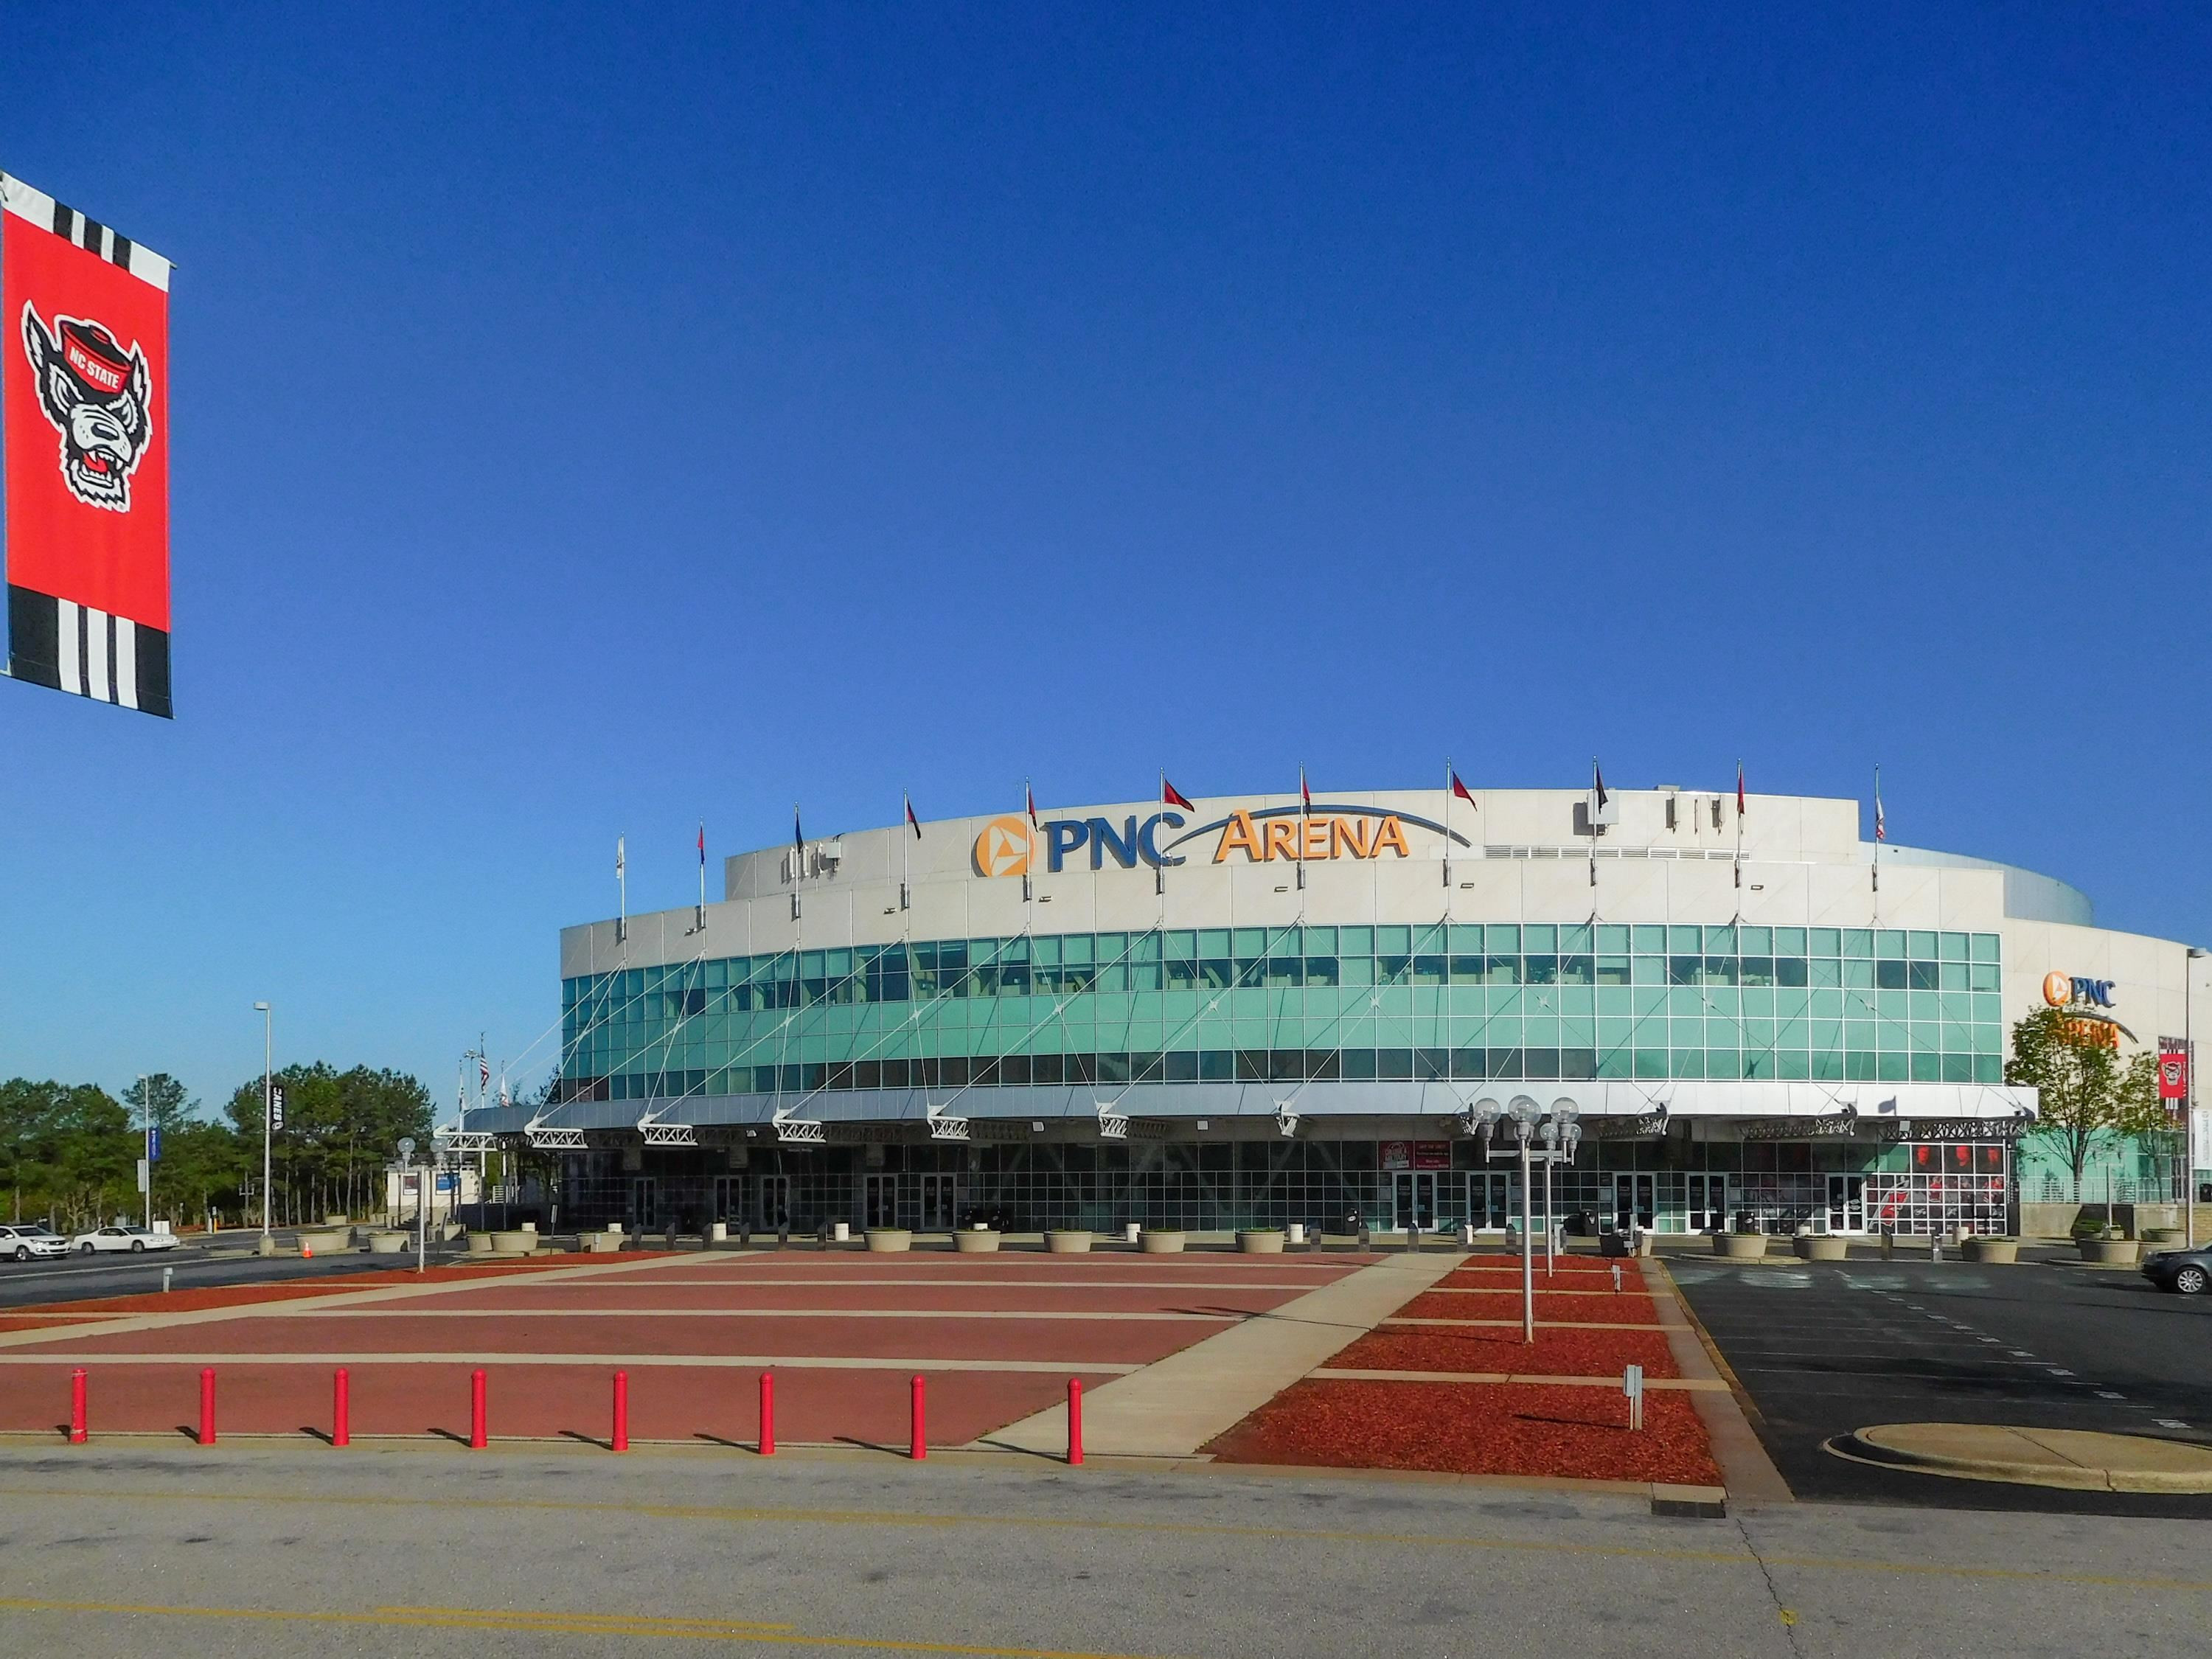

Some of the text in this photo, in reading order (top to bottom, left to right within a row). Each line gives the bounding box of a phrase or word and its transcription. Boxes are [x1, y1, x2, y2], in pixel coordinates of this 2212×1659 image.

[69, 346, 120, 389] NC STATE
[1040, 809, 1411, 873] PNC ARENA
[2068, 977, 2116, 1009] PNC
[273, 1087, 283, 1121] CANES
